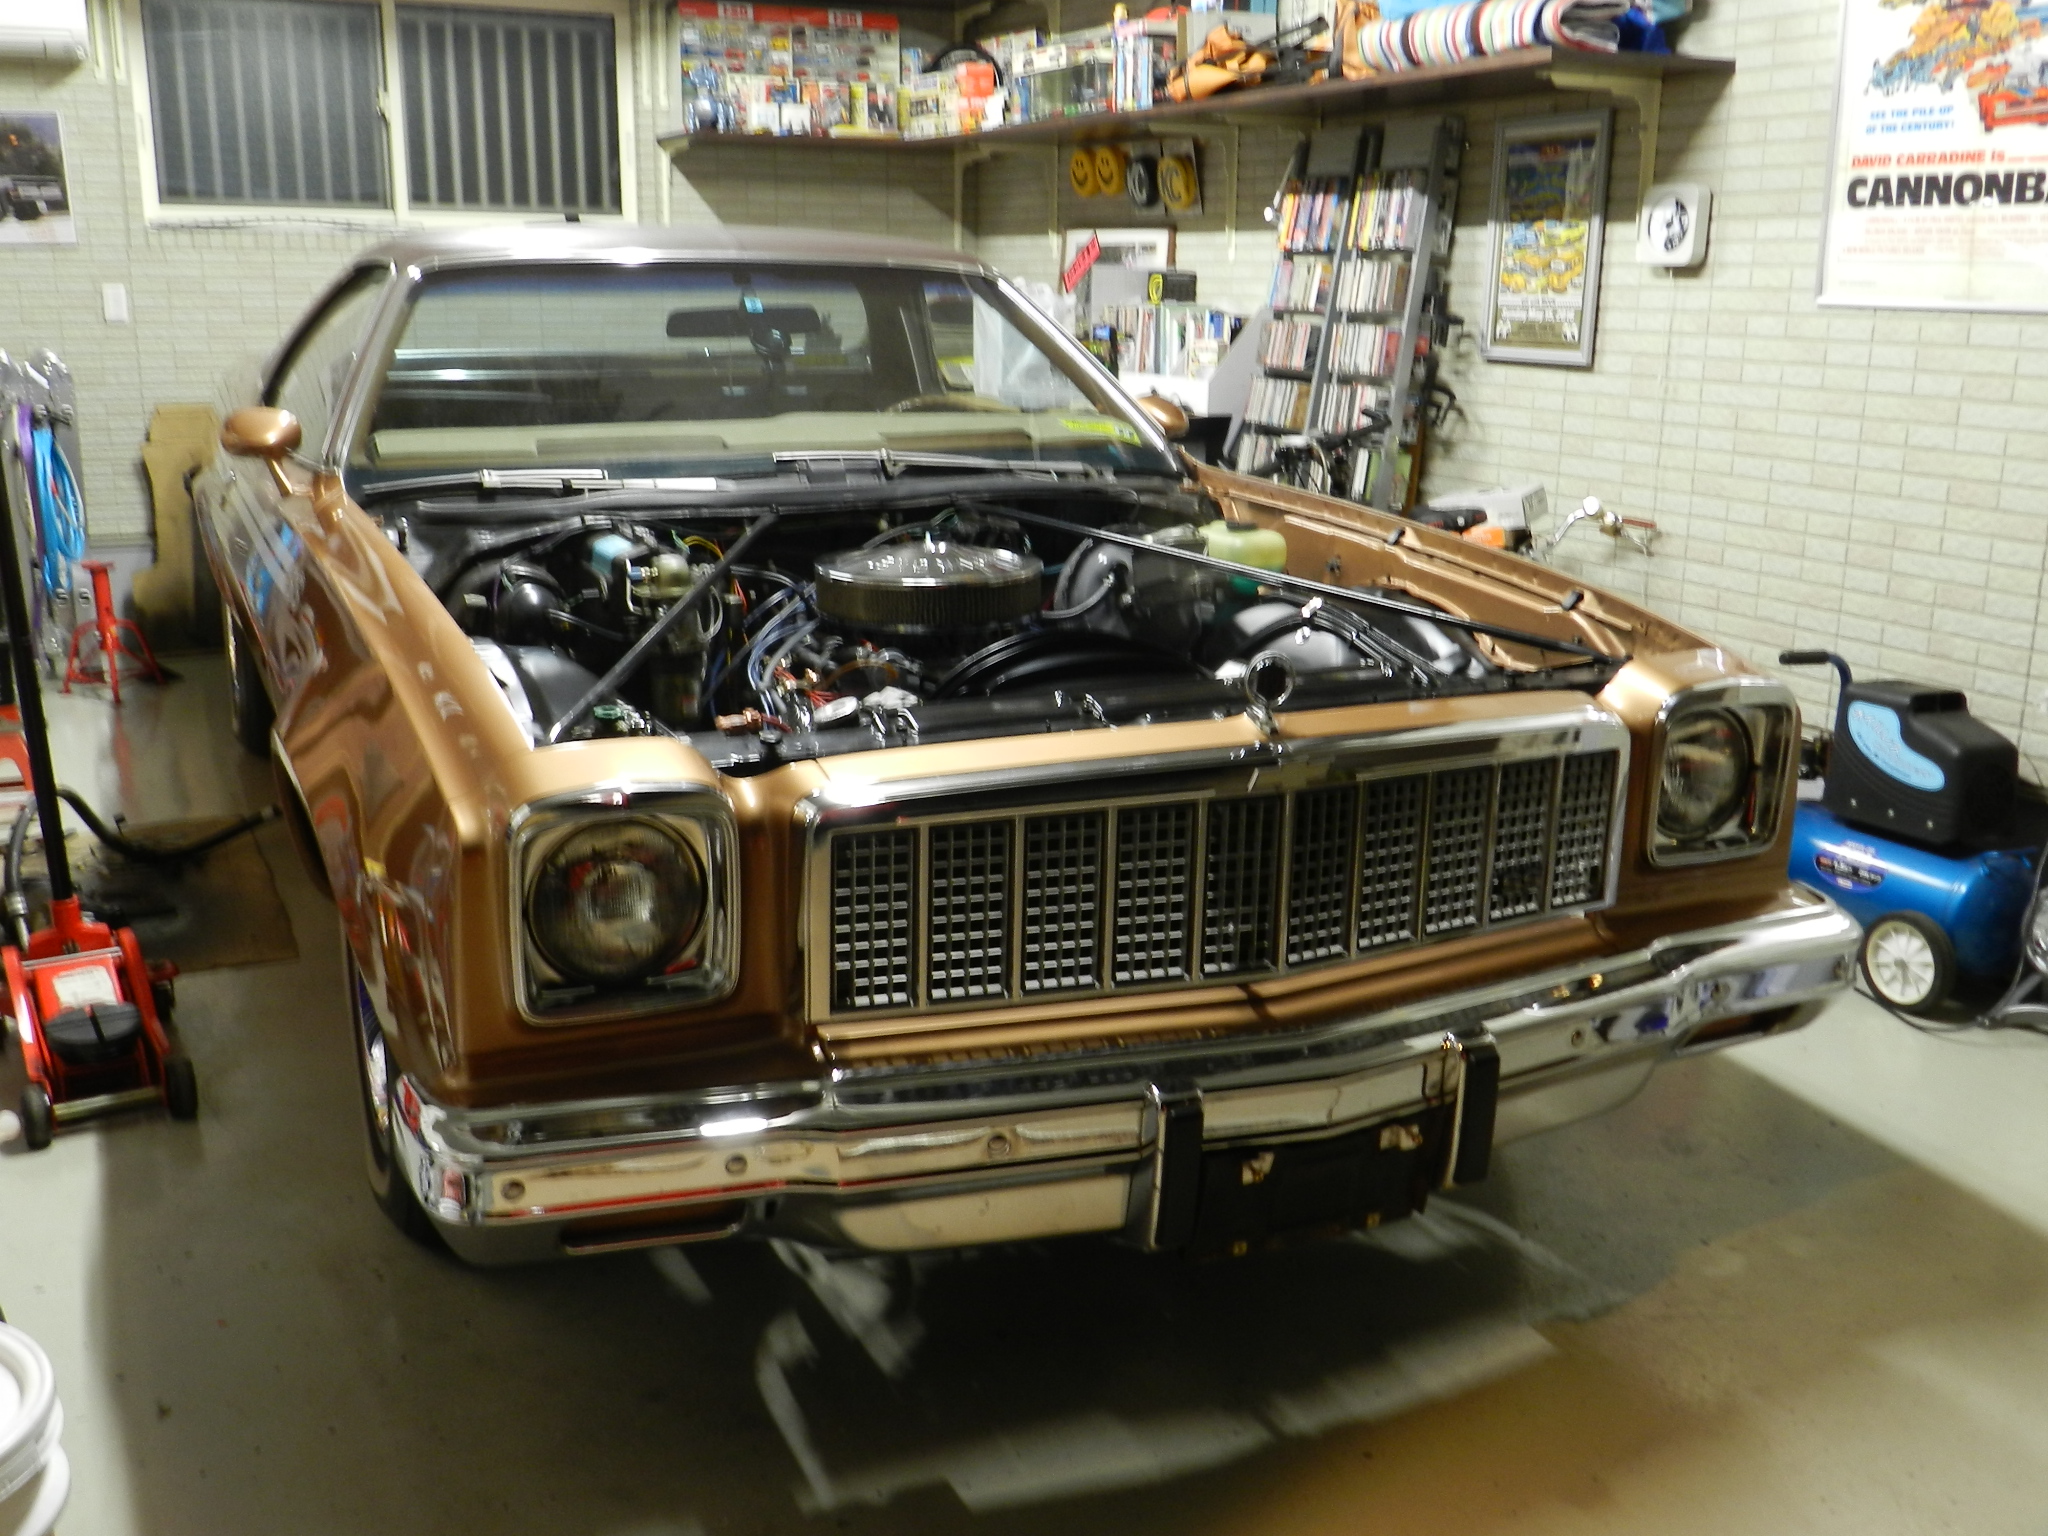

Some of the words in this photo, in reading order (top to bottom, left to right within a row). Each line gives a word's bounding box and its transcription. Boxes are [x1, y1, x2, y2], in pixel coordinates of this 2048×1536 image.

[1891, 108, 1908, 119] THE
[1881, 122, 1898, 133] THE
[1851, 153, 1892, 169] DAVID
[1896, 149, 1986, 167] CARRADINE
[1847, 168, 2048, 209] CANNONB
